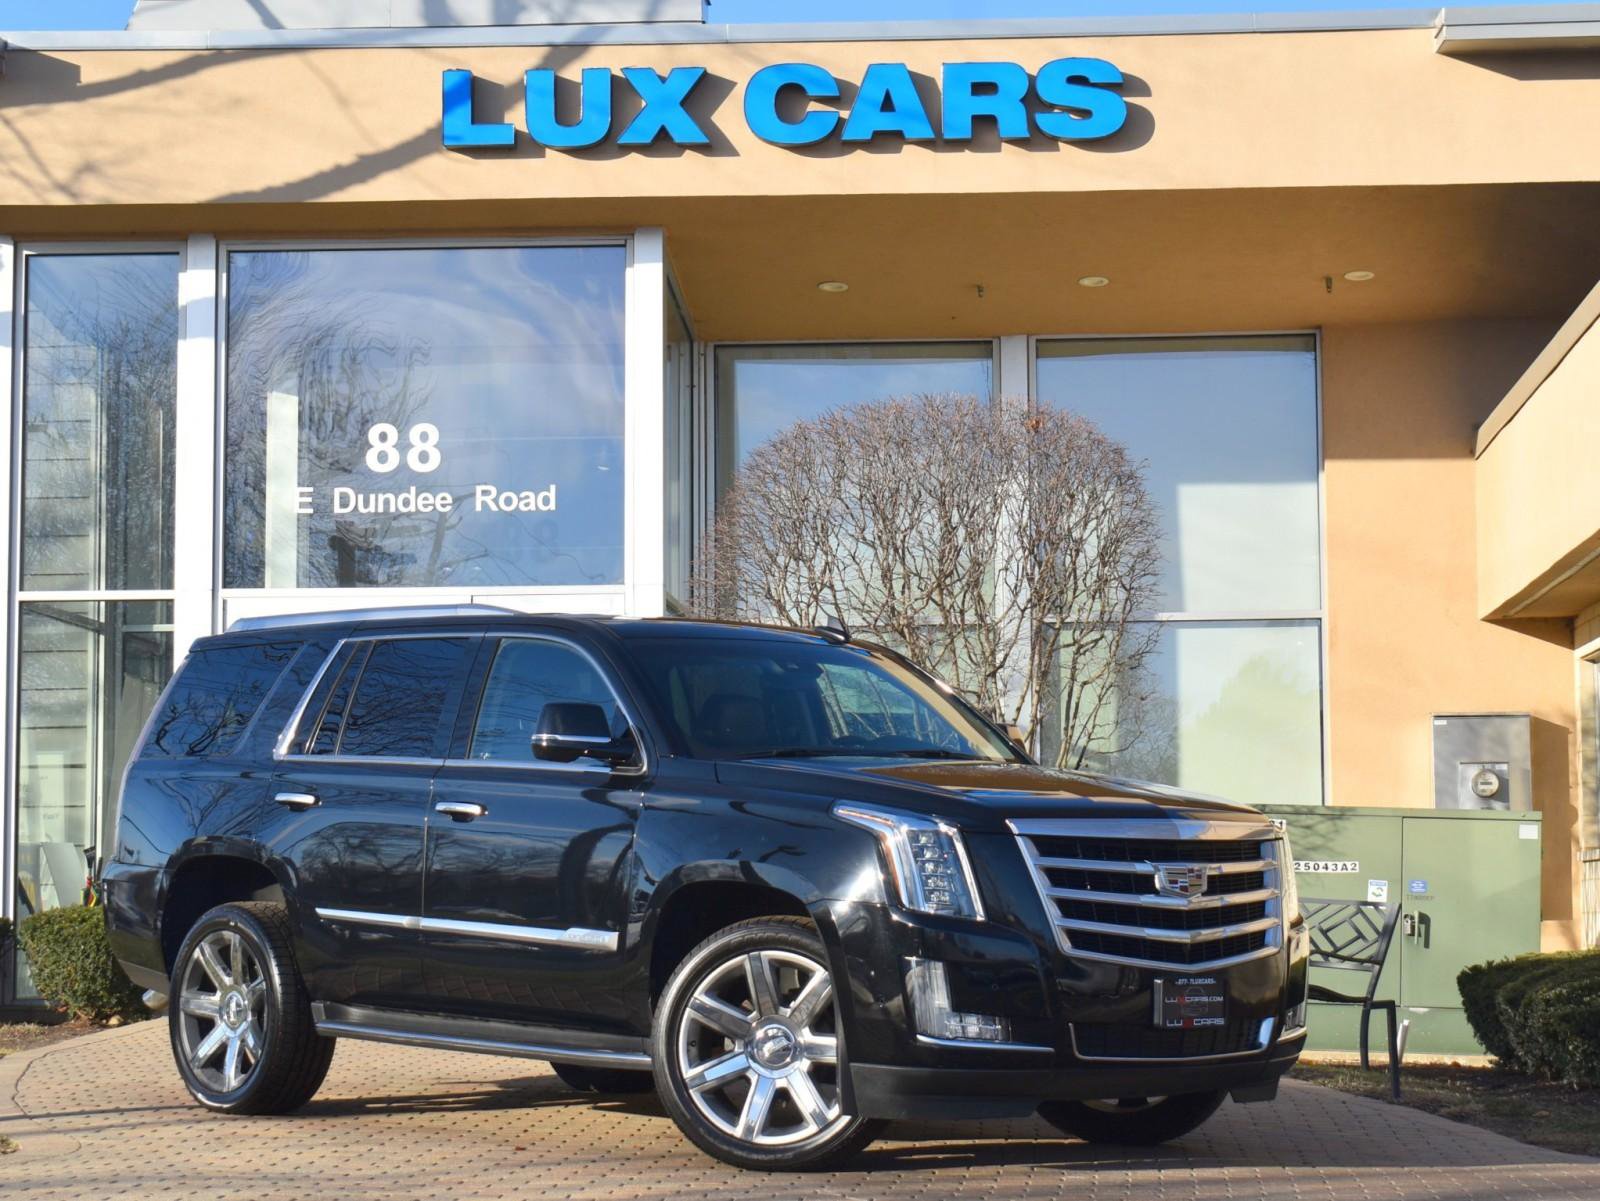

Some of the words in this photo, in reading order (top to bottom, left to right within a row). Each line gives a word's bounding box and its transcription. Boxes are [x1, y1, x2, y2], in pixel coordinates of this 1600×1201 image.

[441, 66, 710, 150] LUX
[743, 57, 1127, 148] CARS
[365, 422, 442, 473] 88
[294, 486, 314, 514] E
[333, 486, 452, 514] Dundee
[475, 484, 556, 513] Road
